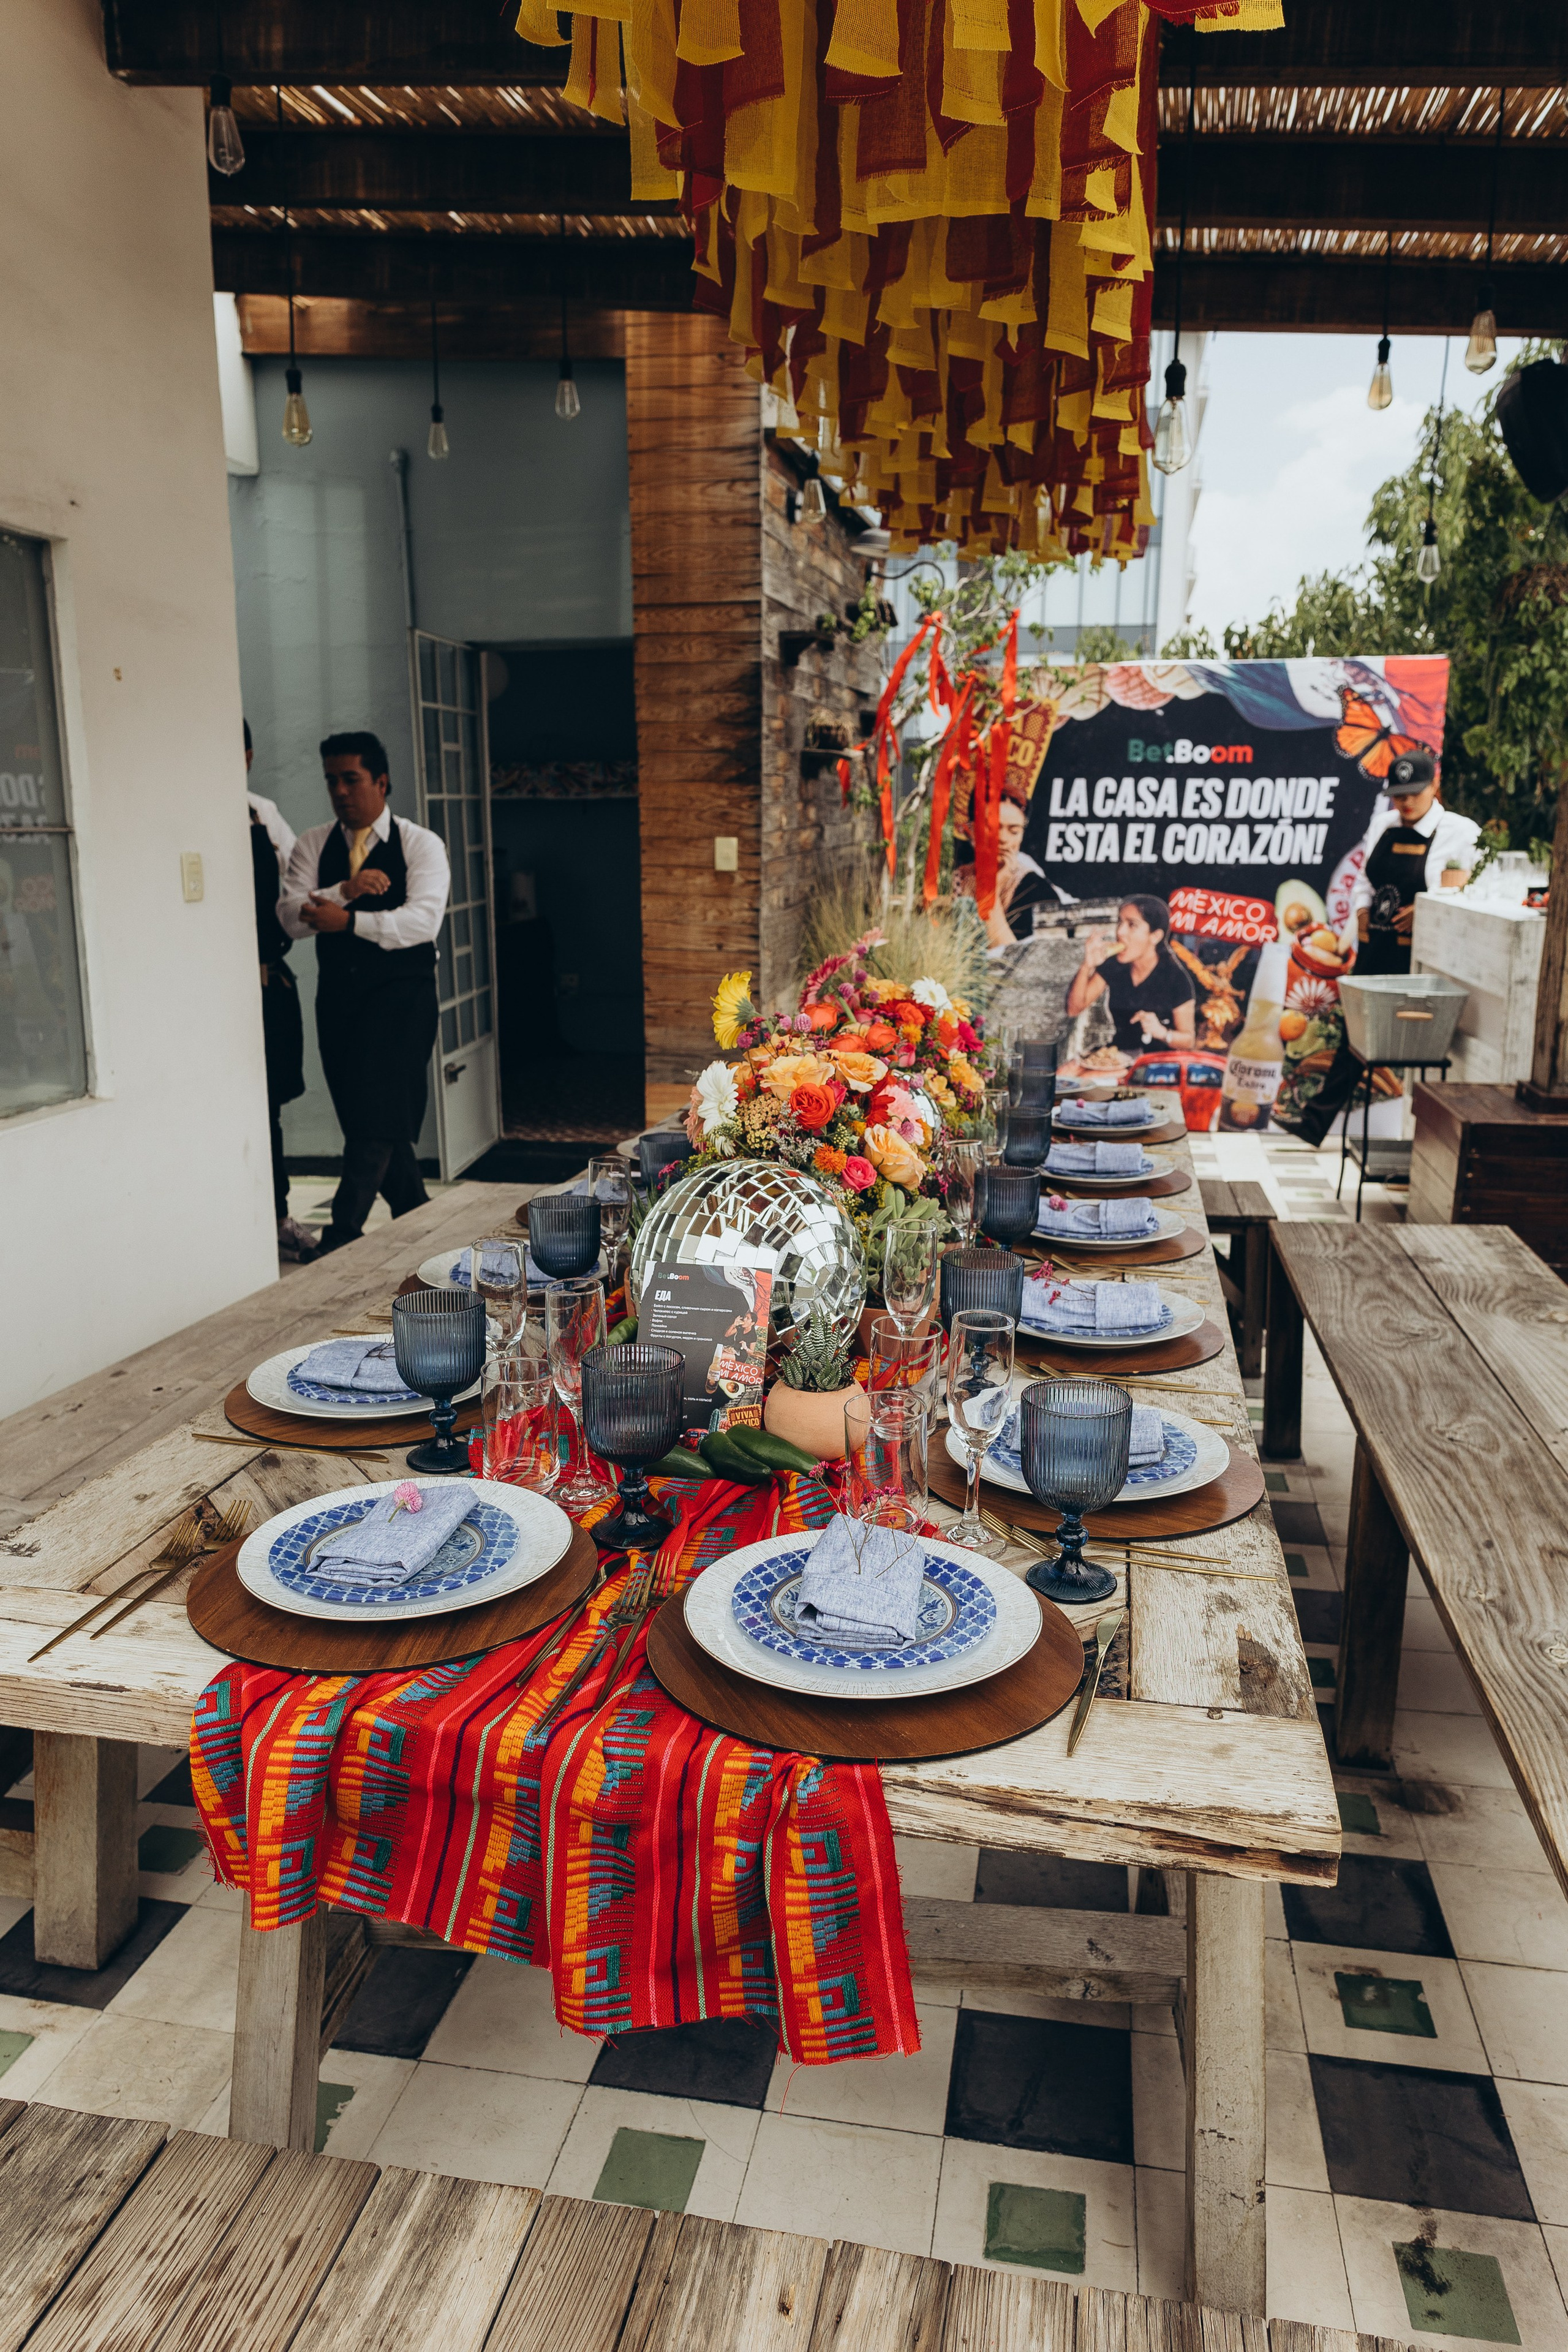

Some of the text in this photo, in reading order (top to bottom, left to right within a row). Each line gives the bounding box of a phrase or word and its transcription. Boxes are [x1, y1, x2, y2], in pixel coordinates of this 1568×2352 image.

[1049, 776, 1340, 819] LA CASA ES DONDE
[1045, 823, 1120, 863] ESTA
[1123, 823, 1158, 864] EL
[1162, 818, 1329, 865] CORAZÓN!
[1169, 911, 1277, 943] MI AMOR
[655, 1290, 671, 1302] ЕДА
[720, 1369, 729, 1378] MI
[731, 1373, 763, 1385] AMOR
[735, 1410, 754, 1420] VIVA
